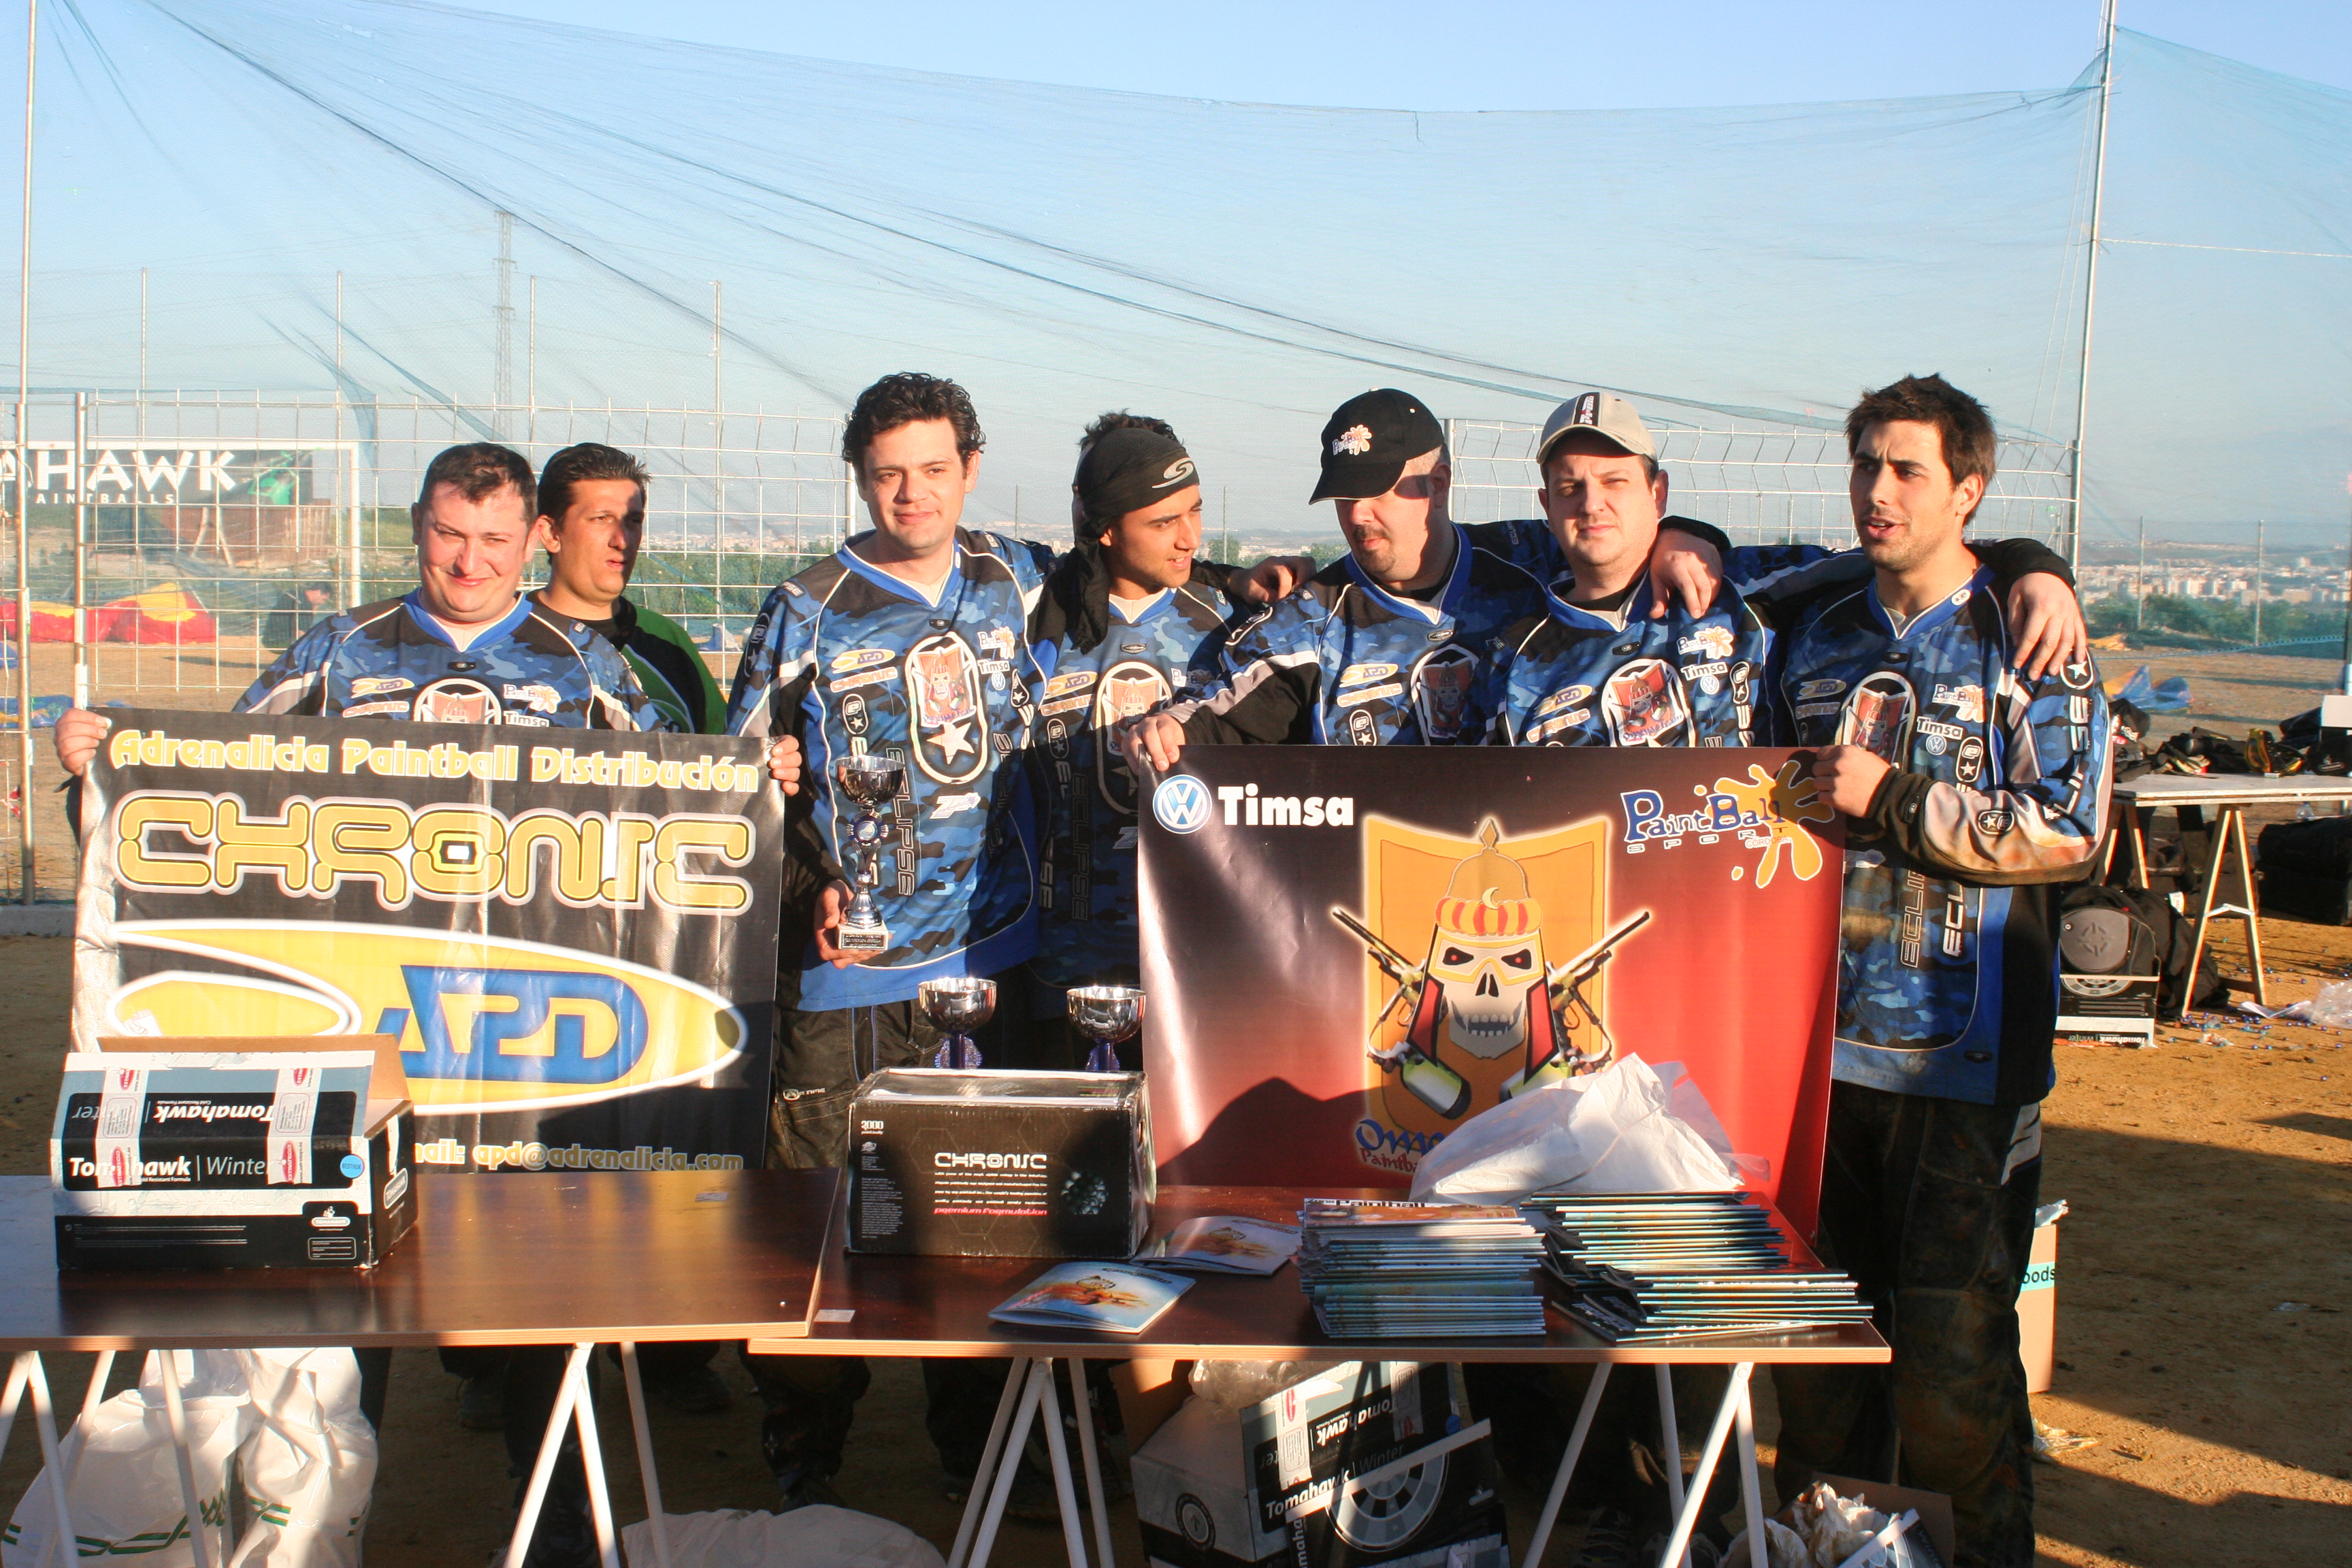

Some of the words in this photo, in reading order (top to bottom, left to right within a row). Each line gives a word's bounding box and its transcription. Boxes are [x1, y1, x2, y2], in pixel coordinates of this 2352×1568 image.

[34, 493, 175, 505] AINTBALLS
[979, 661, 1009, 673] Timsa
[1682, 663, 1726, 679] Timsa
[506, 713, 549, 727] Timsa
[1918, 718, 1961, 737] Timsa
[110, 730, 330, 774] Adrenalicia
[342, 738, 519, 781] Paintball
[531, 746, 759, 793] Distribución
[1218, 783, 1354, 826] Timsa
[1620, 789, 1786, 843] PaintBall
[112, 789, 756, 916] CHRONIC
[1072, 772, 1089, 921] ECLIPSE
[376, 965, 649, 1085] APD
[153, 1104, 275, 1123] Tomahawk
[861, 1120, 884, 1130] 2000
[69, 1155, 191, 1177] Tomhawk
[206, 1155, 266, 1175] Winte
[473, 1141, 744, 1171] apd@adrenalicia.com
[934, 1152, 1047, 1169] CHRONIC
[1316, 1399, 1399, 1447] Tomahawk
[1265, 1467, 1352, 1520] Tomahawk
[1360, 1443, 1405, 1473] Winter
